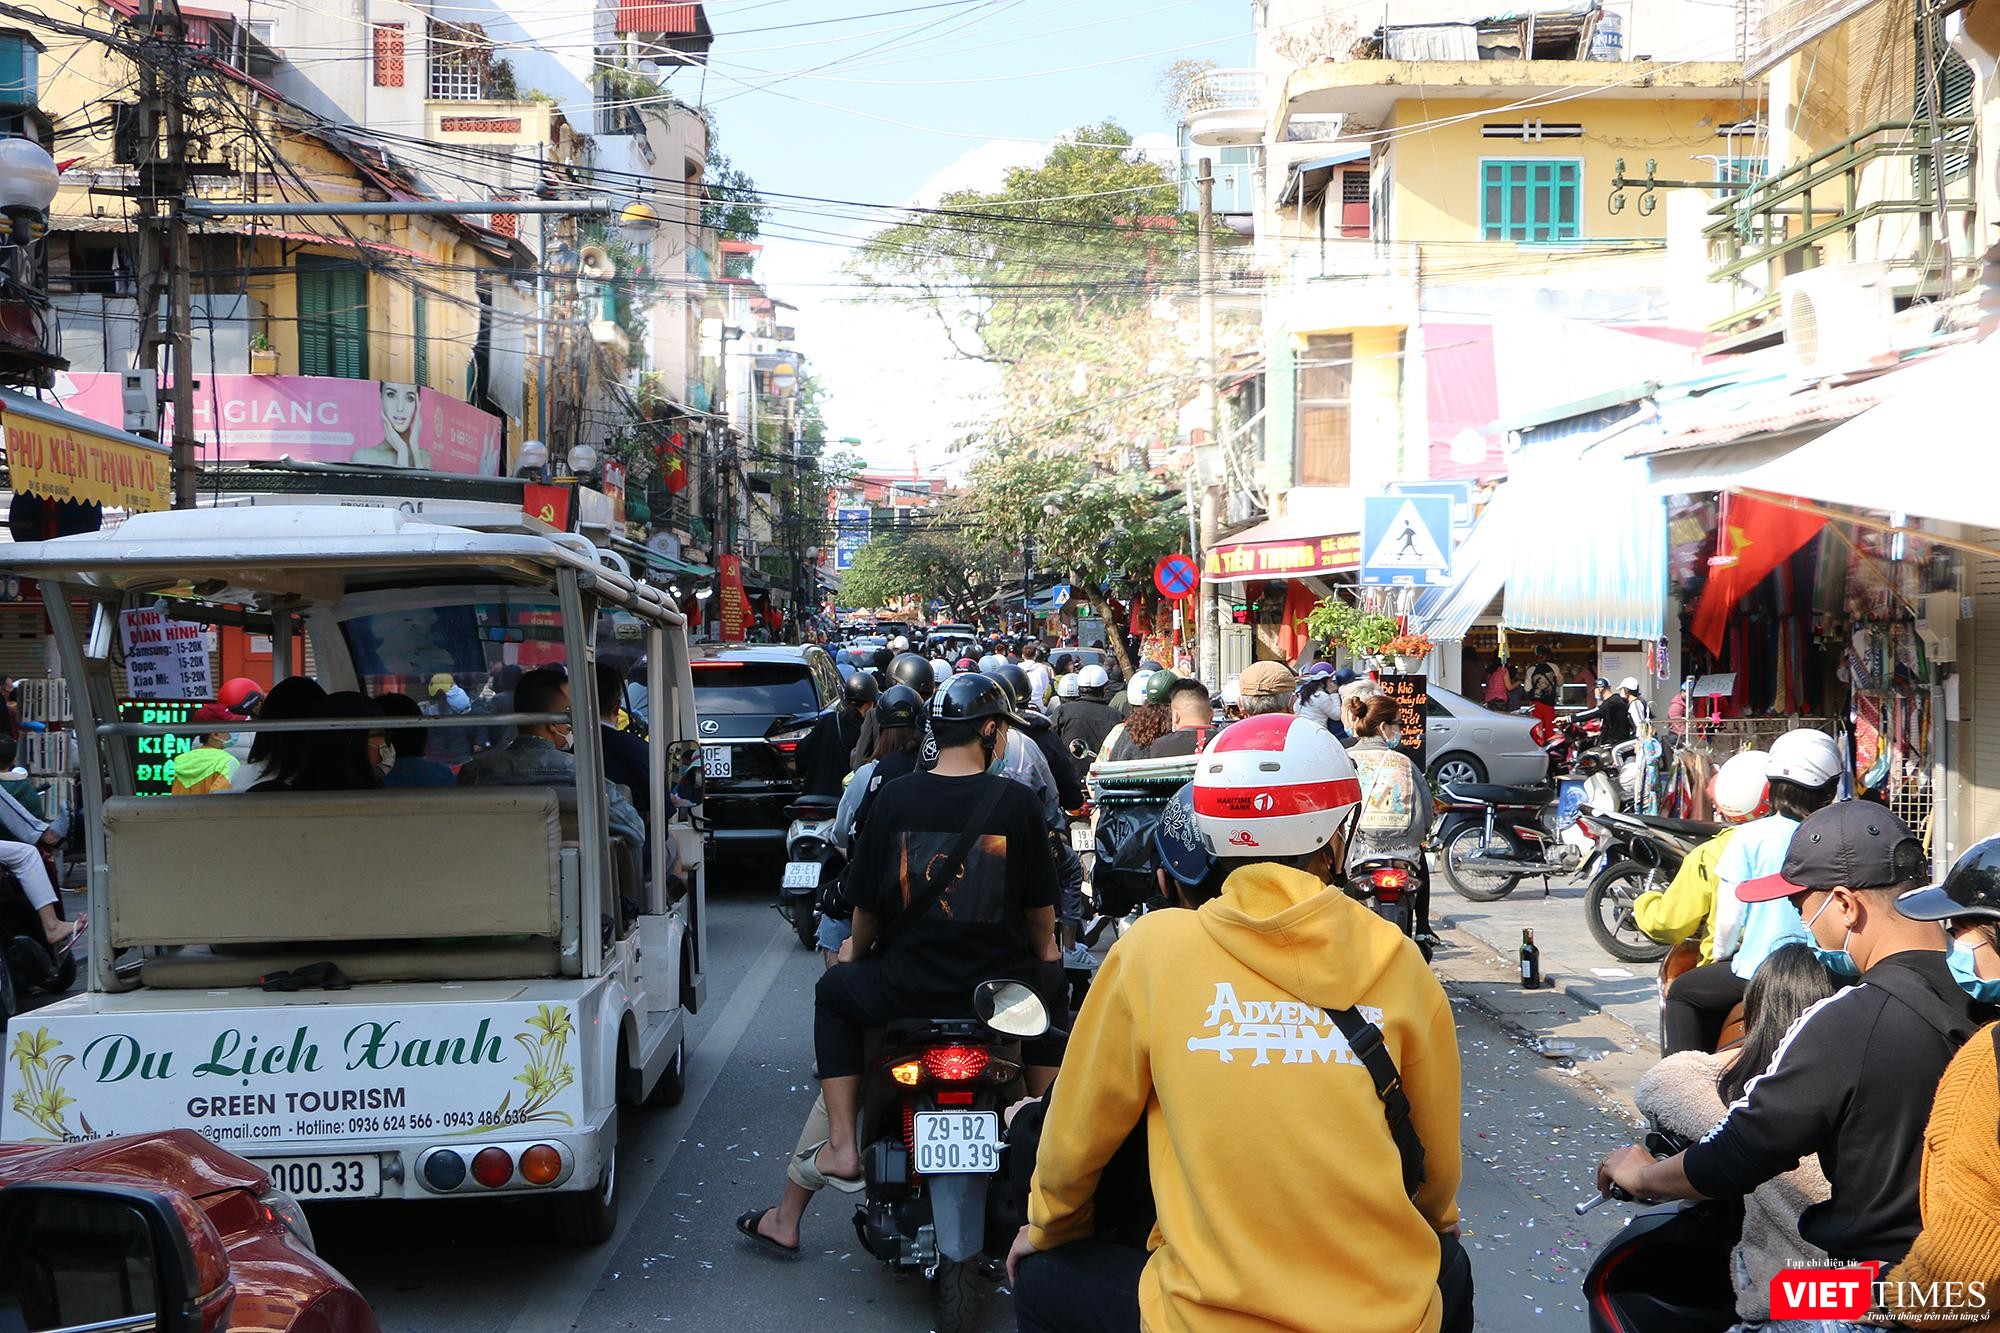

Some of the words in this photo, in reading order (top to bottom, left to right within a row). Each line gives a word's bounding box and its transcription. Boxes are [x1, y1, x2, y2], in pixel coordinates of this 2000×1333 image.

[223, 399, 339, 426] GIANG
[7, 426, 44, 478] PHỤ
[49, 432, 88, 484] KIỆN
[90, 446, 134, 492] THỊNH
[1258, 545, 1315, 573] THỊNH
[127, 611, 160, 626] KNH
[166, 624, 198, 640] HÌNH
[176, 641, 203, 654] 15-20K
[131, 661, 156, 673] Oppo:
[179, 656, 204, 669] 15-20K
[133, 675, 154, 688] Xiao
[181, 670, 206, 684] 15-20K
[1381, 681, 1394, 694] Bò
[183, 686, 208, 698] 15-20K
[138, 733, 191, 758] KIỆN
[82, 1033, 177, 1084] Du
[192, 1025, 325, 1087] Lịch
[343, 1017, 508, 1072] Xanh
[186, 1093, 276, 1118] GREEN
[285, 1086, 406, 1114] TOURISM
[296, 1120, 345, 1136] Hotline:
[348, 1117, 379, 1133] 0936
[383, 1116, 406, 1131] 624
[409, 1113, 433, 1130] 566
[443, 1111, 474, 1128] 0943
[477, 1110, 501, 1126] 486
[504, 1109, 527, 1125] 636
[927, 1116, 985, 1141] 29-B2
[920, 1143, 993, 1168] 090.39
